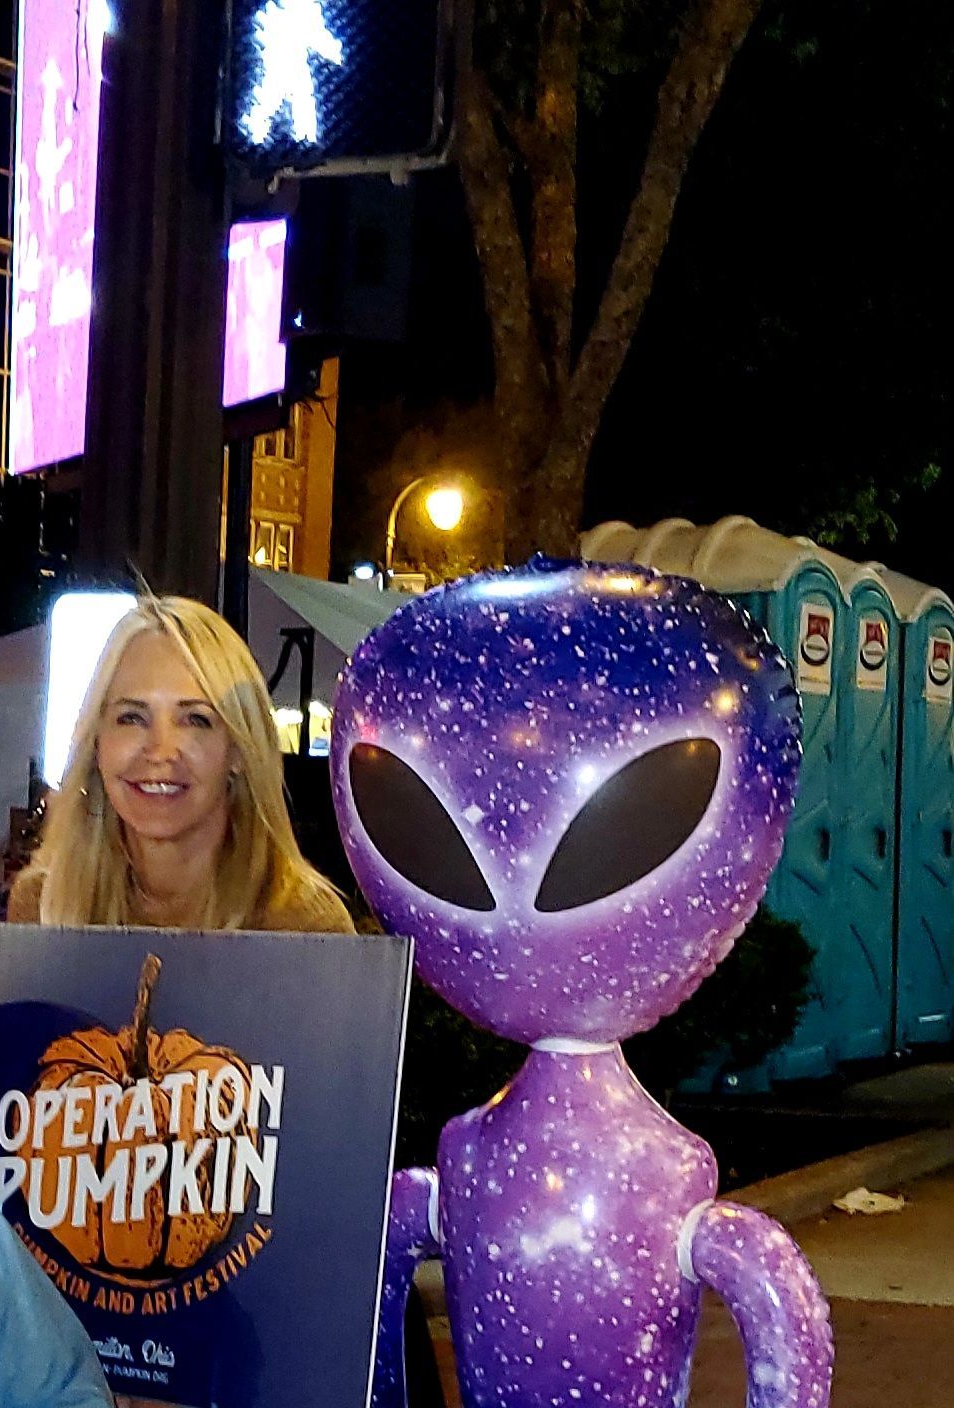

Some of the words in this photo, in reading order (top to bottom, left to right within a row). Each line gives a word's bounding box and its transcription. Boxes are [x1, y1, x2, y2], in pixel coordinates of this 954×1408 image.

[93, 1287, 134, 1315] AND
[141, 1287, 177, 1315] ART
[182, 1221, 272, 1306] FESTIVAL
